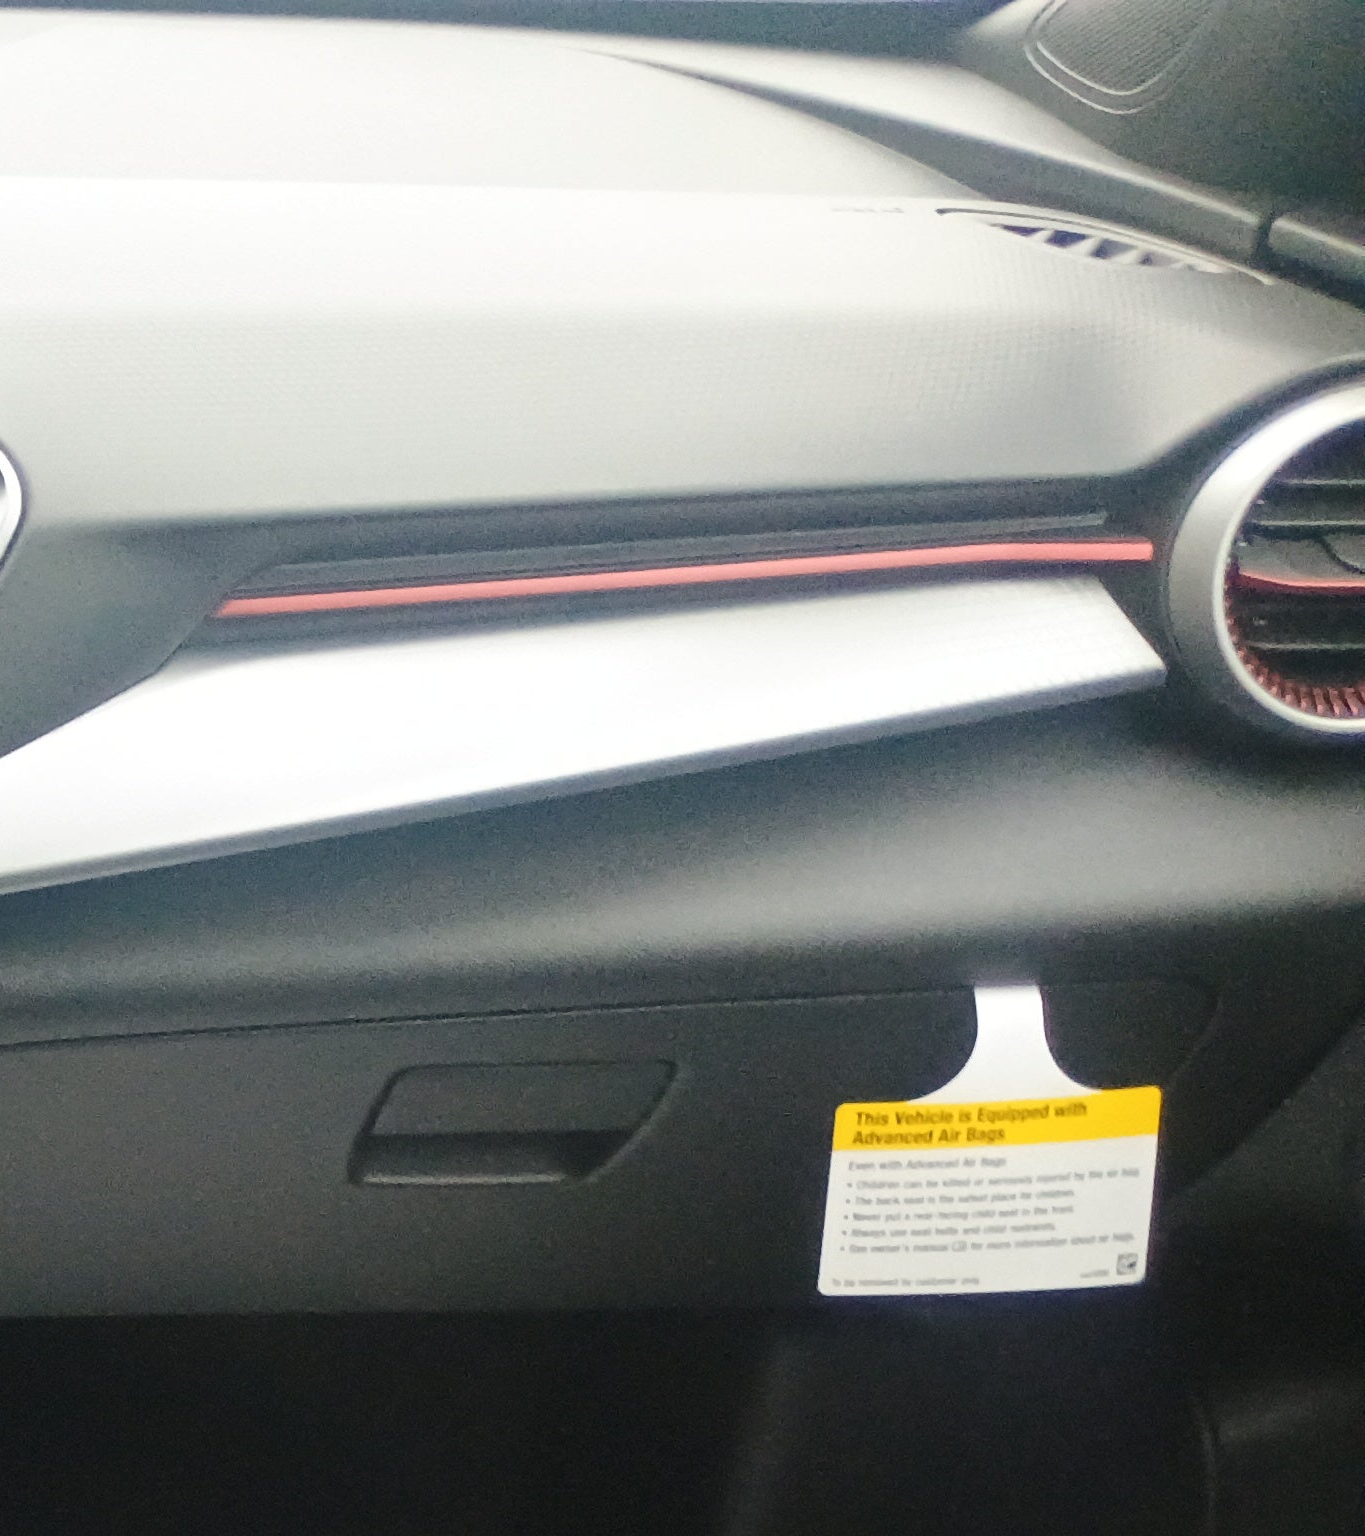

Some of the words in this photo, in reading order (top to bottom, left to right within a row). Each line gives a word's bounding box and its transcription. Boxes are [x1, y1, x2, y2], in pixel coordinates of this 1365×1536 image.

[855, 1111, 889, 1126] This
[895, 1109, 954, 1125] Vehicle
[958, 1109, 972, 1123] is
[977, 1104, 1050, 1124] Equipped
[1054, 1102, 1088, 1117] with
[852, 1130, 933, 1145] Advanced
[938, 1129, 962, 1142] Air
[966, 1127, 1006, 1144] Bags
